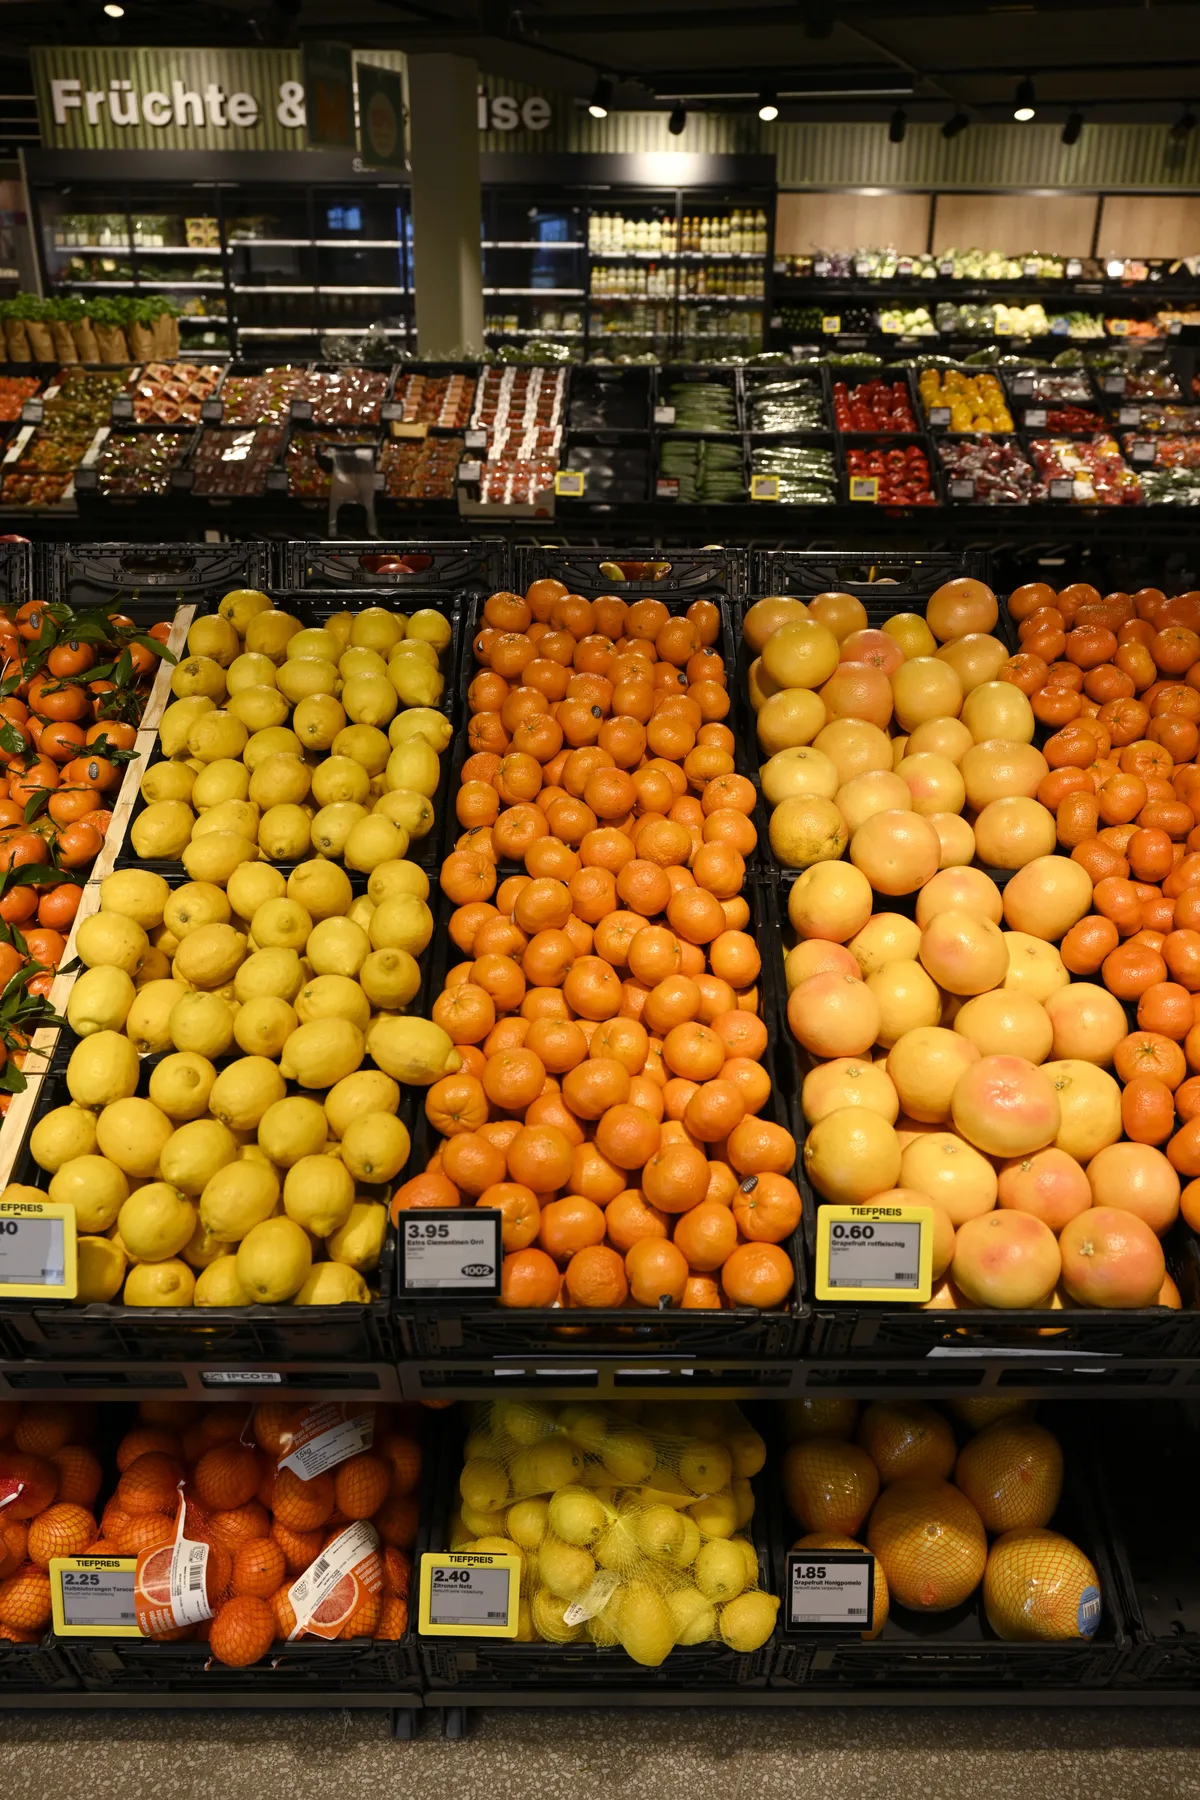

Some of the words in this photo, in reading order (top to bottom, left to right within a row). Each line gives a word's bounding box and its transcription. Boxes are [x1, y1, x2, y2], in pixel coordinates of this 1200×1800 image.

[51, 78, 258, 127] Früchte
[276, 80, 307, 128] &
[851, 1207, 902, 1217] TIEFPREIS
[408, 1224, 450, 1239] 3.95
[832, 1224, 875, 1239] 0.60
[831, 1240, 866, 1248] Grapefruit
[867, 1241, 906, 1249] rotfleischig
[464, 1266, 491, 1275] 1002
[76, 1560, 120, 1568] TIEFPREIS
[448, 1555, 494, 1563] TIEFPREIS
[434, 1570, 471, 1583] 2.40
[794, 1566, 827, 1579] 1.85
[64, 1573, 100, 1586] 2.25
